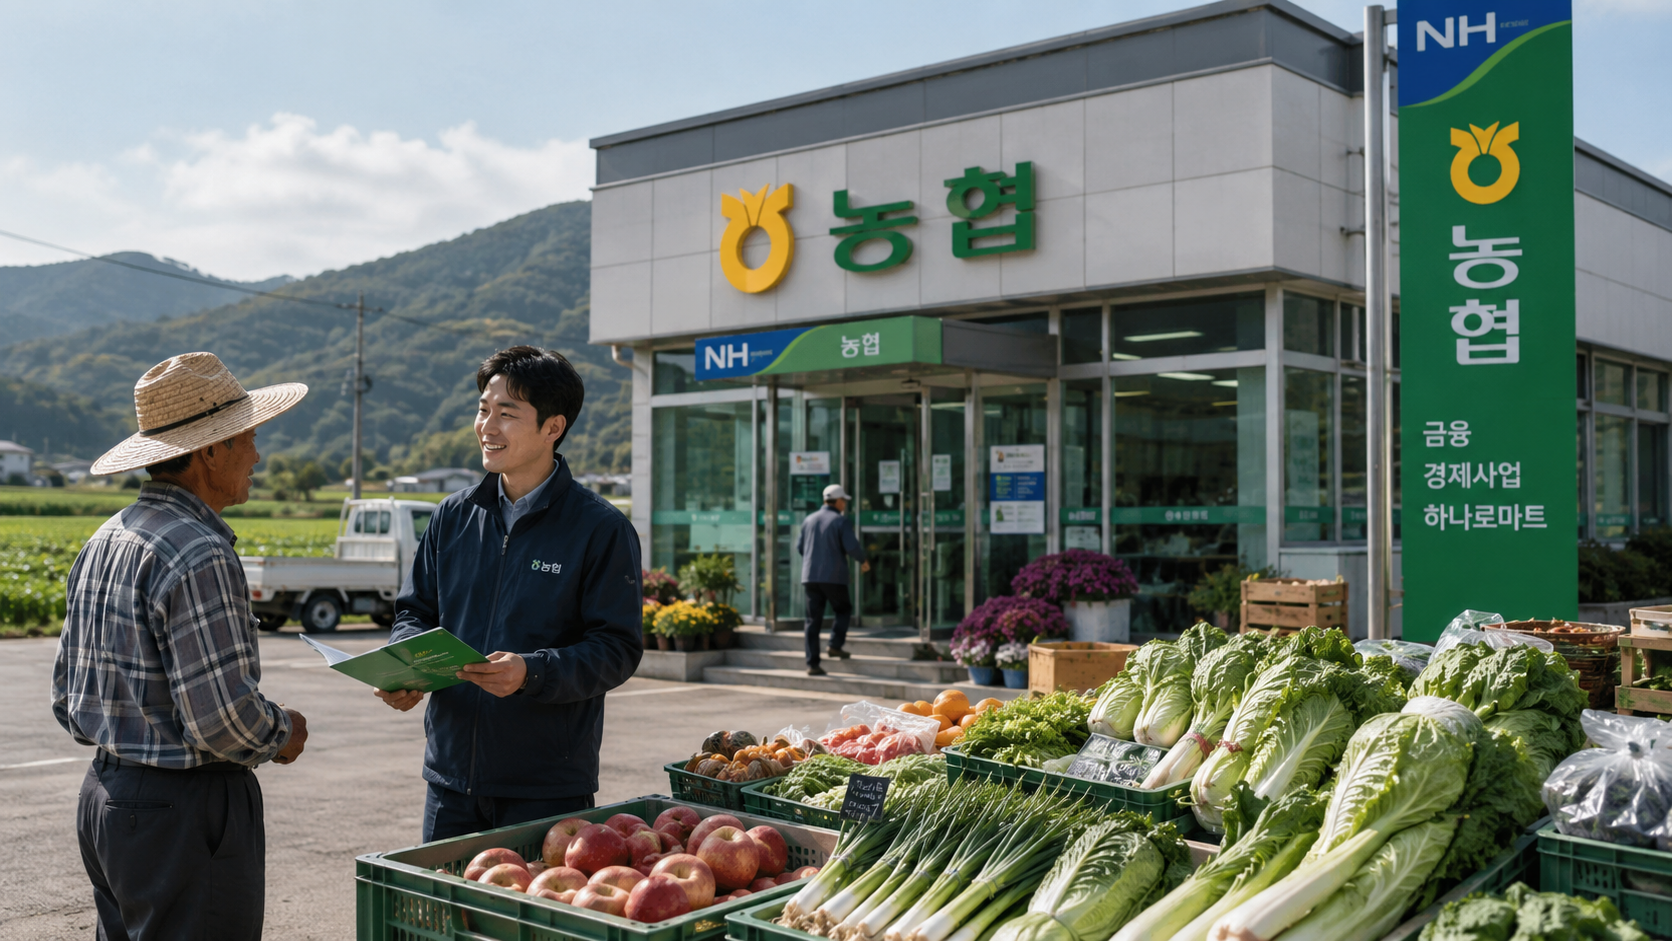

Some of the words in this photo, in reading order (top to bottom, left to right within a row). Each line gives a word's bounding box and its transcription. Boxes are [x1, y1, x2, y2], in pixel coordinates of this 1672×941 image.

[1416, 11, 1496, 52] NH
[829, 160, 1036, 273] 농협
[1448, 225, 1523, 365] 농협
[704, 342, 748, 370] NH
[840, 331, 880, 358] 농협
[1422, 420, 1472, 448] 금융
[1423, 461, 1522, 489] 경제사업
[1423, 503, 1548, 531] 하나로마트
